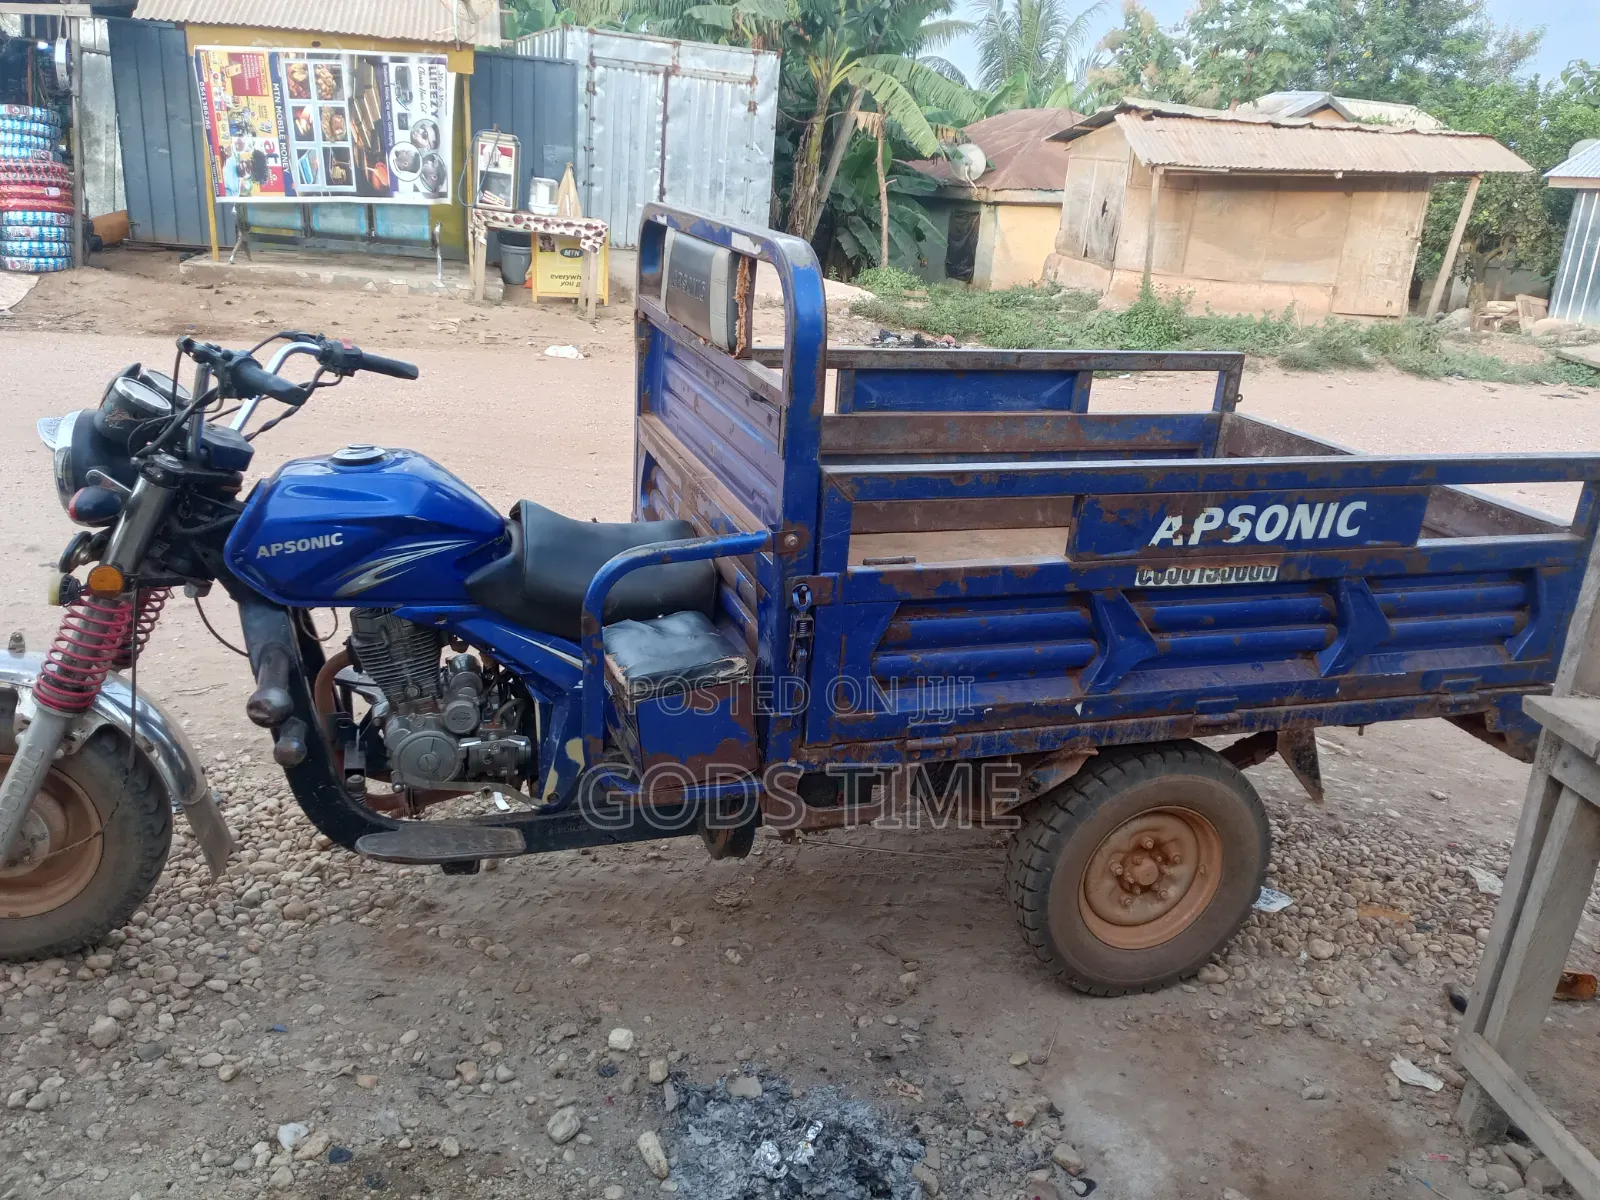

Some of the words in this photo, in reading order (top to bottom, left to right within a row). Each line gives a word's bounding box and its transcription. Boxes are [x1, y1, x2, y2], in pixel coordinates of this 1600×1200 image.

[272, 82, 281, 103] MTN
[428, 66, 439, 118] WEEZY
[275, 105, 286, 140] MOBILE
[279, 142, 290, 174] MONEY
[1147, 501, 1367, 547] APSONIC
[256, 532, 344, 559] APSONIC
